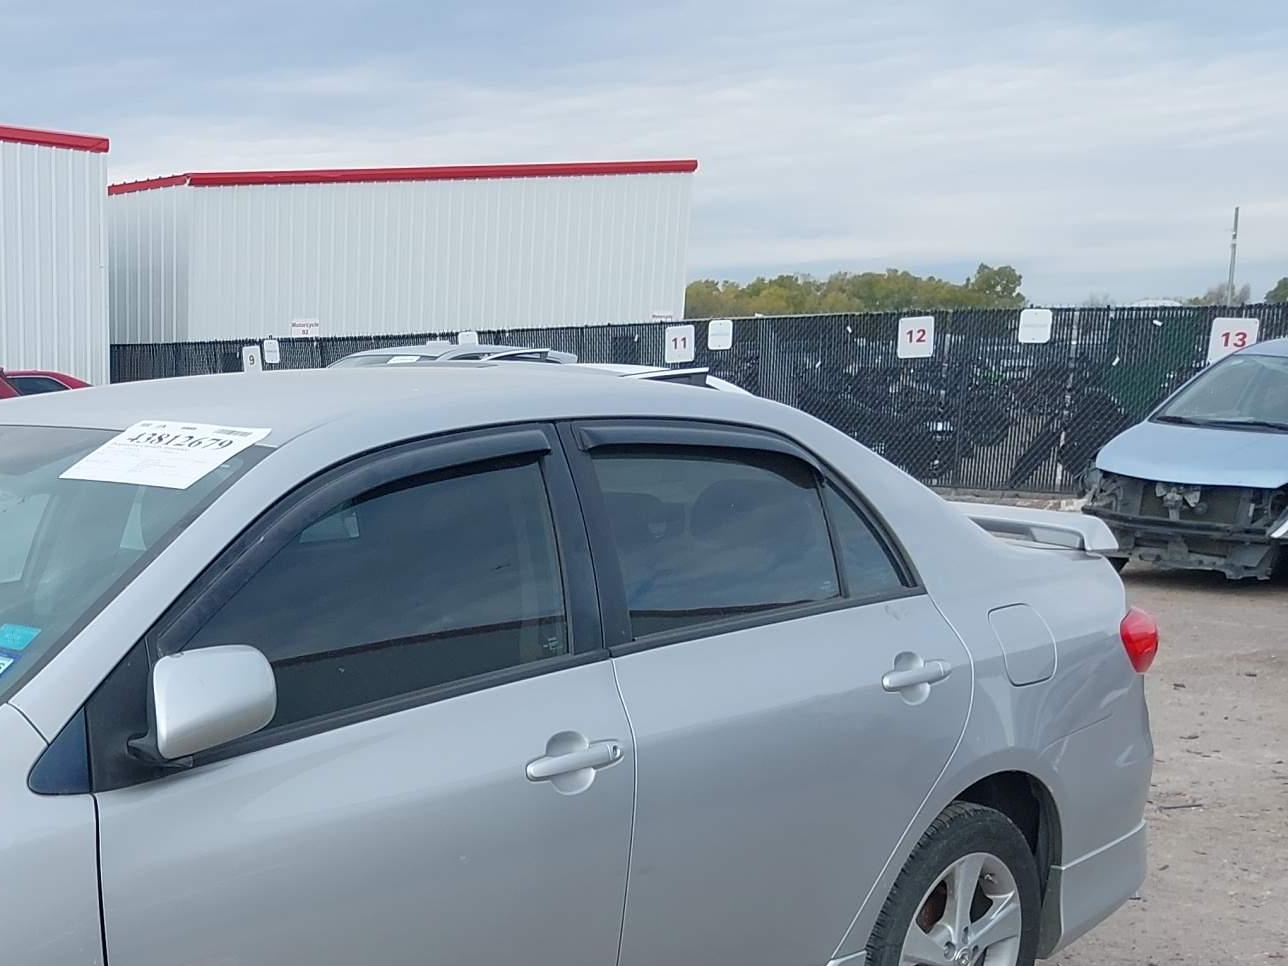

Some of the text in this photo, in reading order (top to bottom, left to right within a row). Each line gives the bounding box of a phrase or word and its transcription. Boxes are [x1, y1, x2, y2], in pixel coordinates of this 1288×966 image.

[671, 336, 687, 350] 11
[906, 328, 926, 343] 12
[1221, 331, 1248, 348] 13
[248, 354, 255, 365] 9
[127, 432, 234, 450] 43812679
